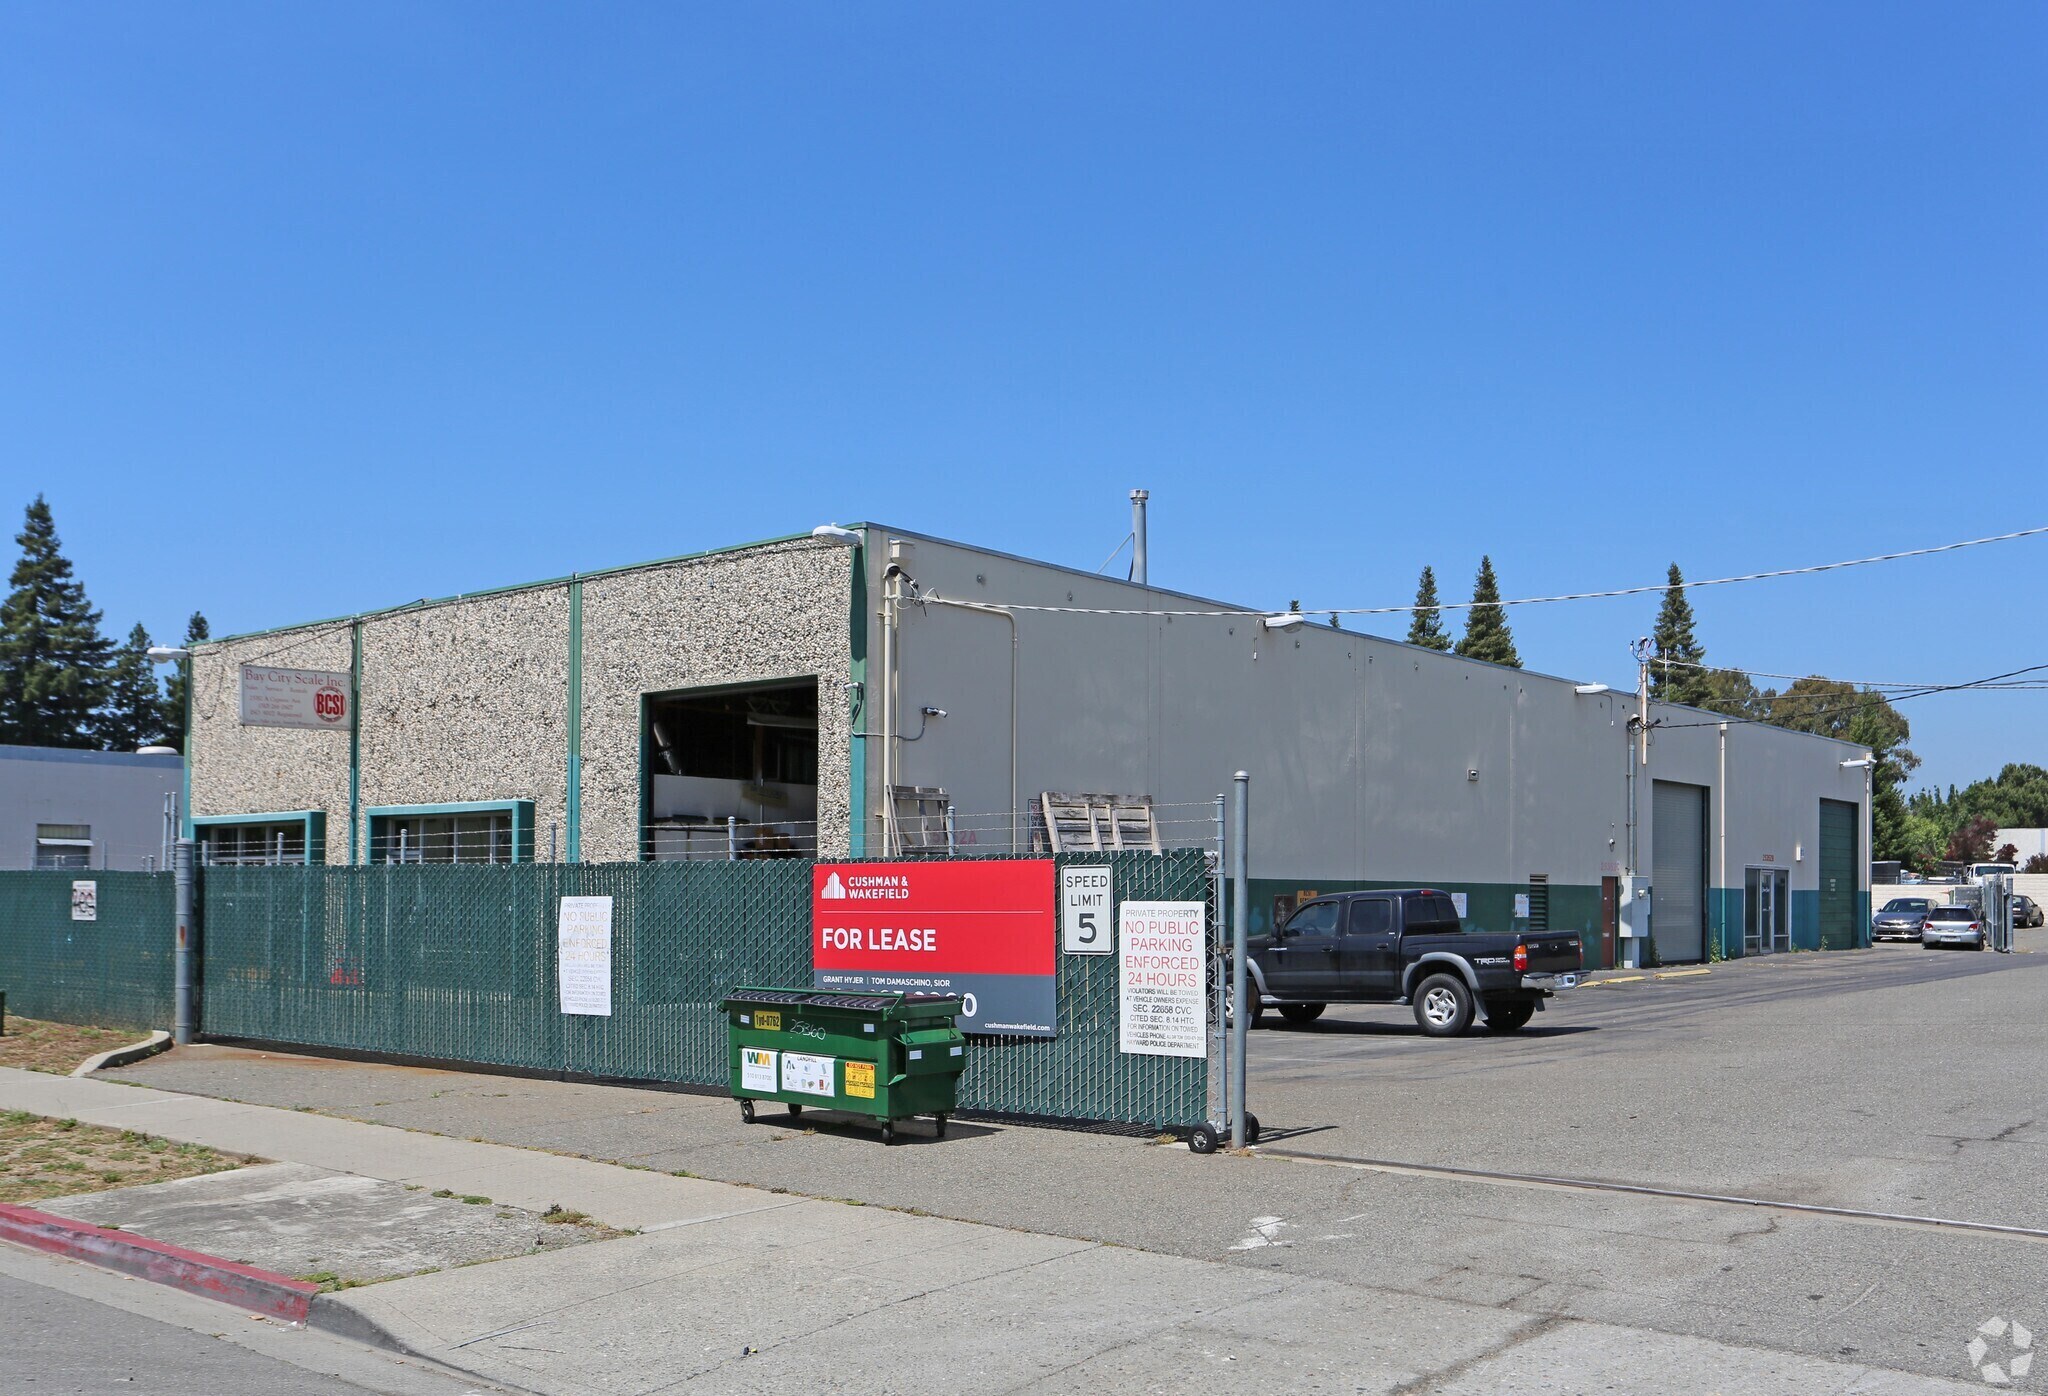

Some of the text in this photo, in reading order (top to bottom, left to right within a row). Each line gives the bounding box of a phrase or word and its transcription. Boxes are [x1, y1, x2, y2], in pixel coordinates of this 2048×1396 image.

[245, 668, 346, 687] Bay City Scale Inc.
[316, 693, 344, 716] BCSI
[848, 876, 908, 887] CUSHMAN &
[1066, 876, 1108, 888] SPEED
[848, 888, 909, 899] WAKEFIELD
[1070, 894, 1103, 906] LIMIT
[563, 912, 608, 922] NO PUBLIC
[1125, 909, 1199, 918] PRIVATE PROPERTY
[567, 924, 604, 935] PARKING
[1078, 913, 1097, 944] 5
[1125, 921, 1199, 935] NO PUBLIC
[563, 938, 607, 949] ENFORCED
[822, 928, 936, 951] FOR LEASE
[1131, 938, 1192, 952] PARKING
[565, 951, 606, 962] 24 HOURS
[1125, 956, 1199, 970] ENFORCED
[822, 976, 864, 984] GRANT HYJER
[871, 977, 950, 988] TOM DAMASCHINO, SIOR
[1128, 972, 1197, 987] 24 HOURS
[1132, 1004, 1192, 1014] SEC. 22658 CVC
[984, 1022, 1050, 1032] cushmanwakefield.com
[747, 1052, 770, 1066] WM
